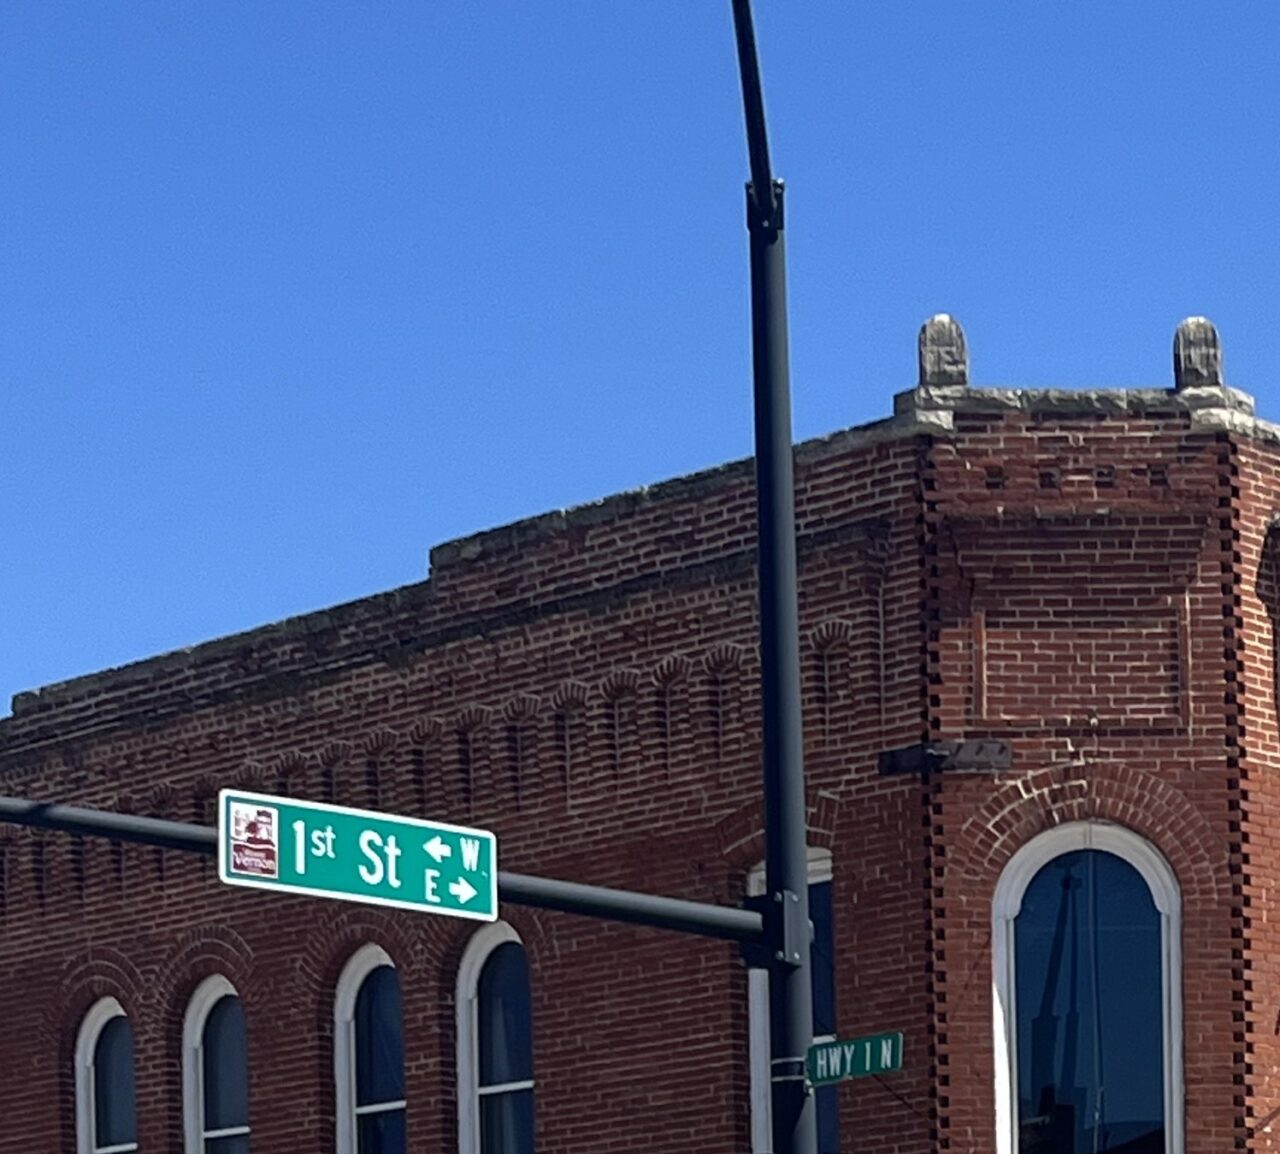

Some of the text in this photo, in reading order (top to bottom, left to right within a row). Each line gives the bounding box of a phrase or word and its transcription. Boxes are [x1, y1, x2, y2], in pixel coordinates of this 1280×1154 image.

[292, 820, 401, 888] 1st St
[459, 836, 480, 873] W
[424, 869, 441, 903] E
[817, 1044, 855, 1079] HWY
[881, 1039, 892, 1069] N
